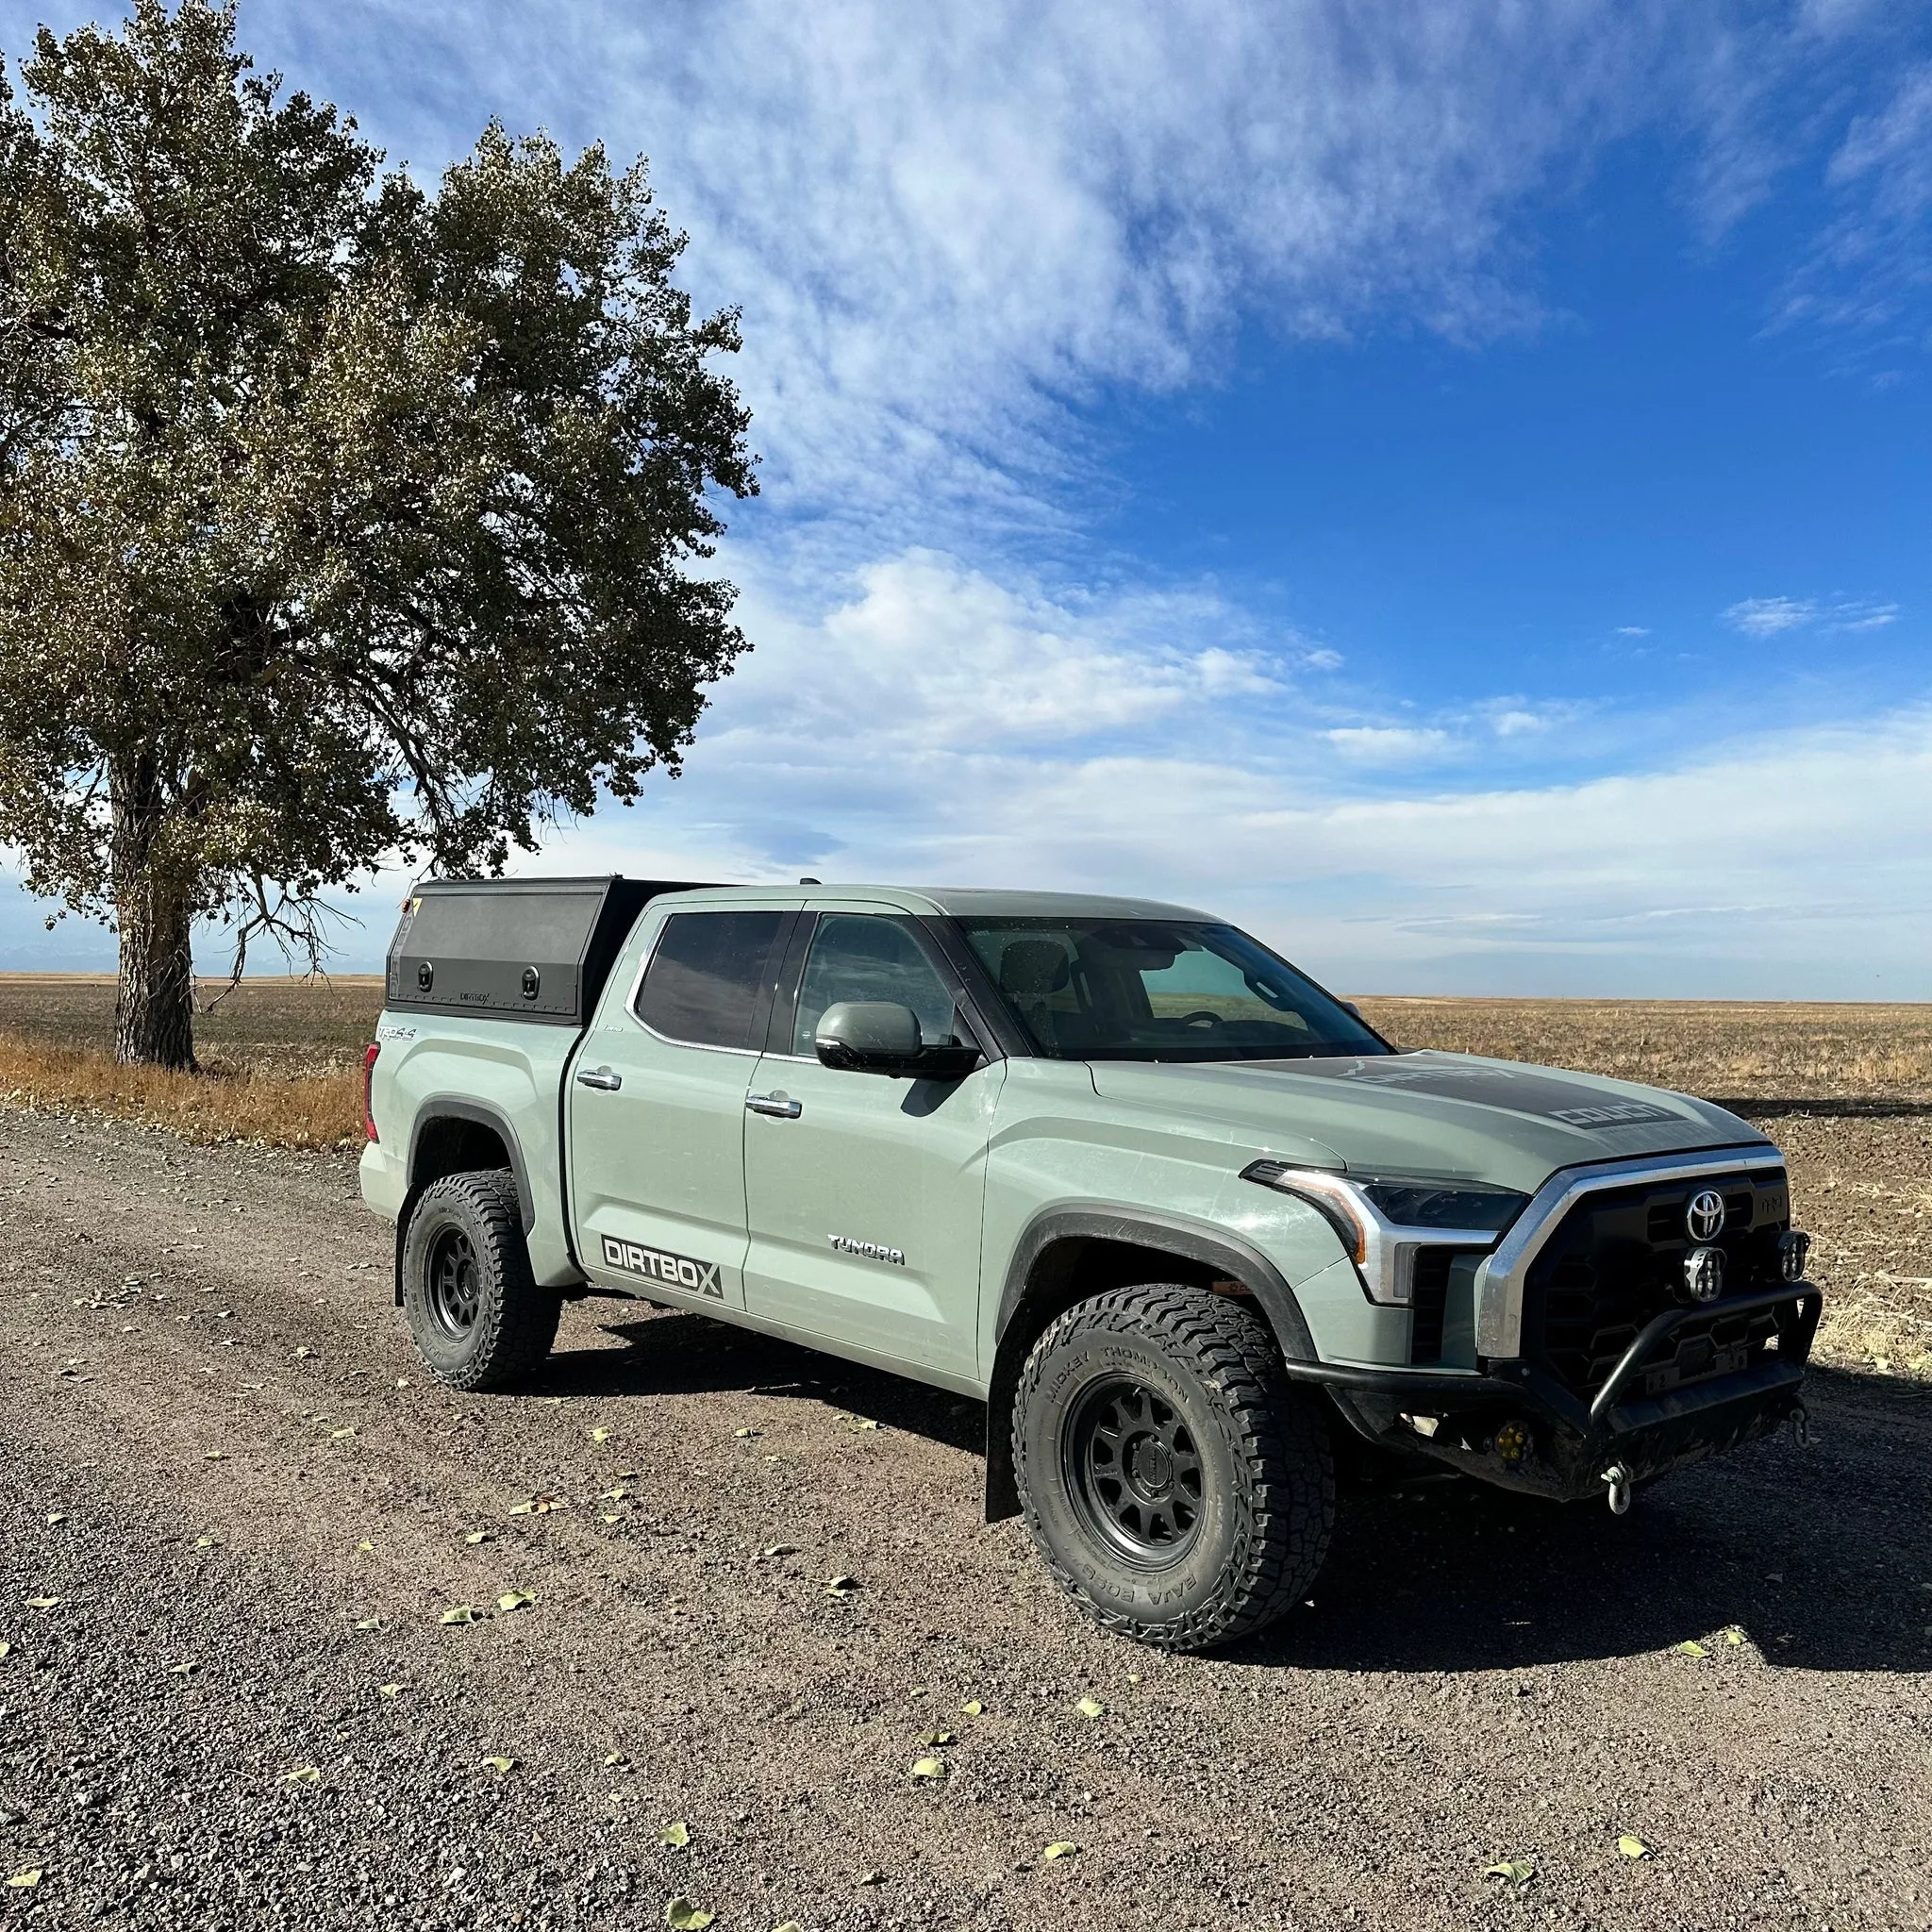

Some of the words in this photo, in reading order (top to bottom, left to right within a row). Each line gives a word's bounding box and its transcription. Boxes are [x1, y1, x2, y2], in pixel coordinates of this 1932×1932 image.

[604, 1239, 721, 1294] DIRTBOX
[827, 1234, 906, 1265] TUNDRA
[1082, 1563, 1136, 1603] BOSS
[1147, 1573, 1197, 1606] BAJA
